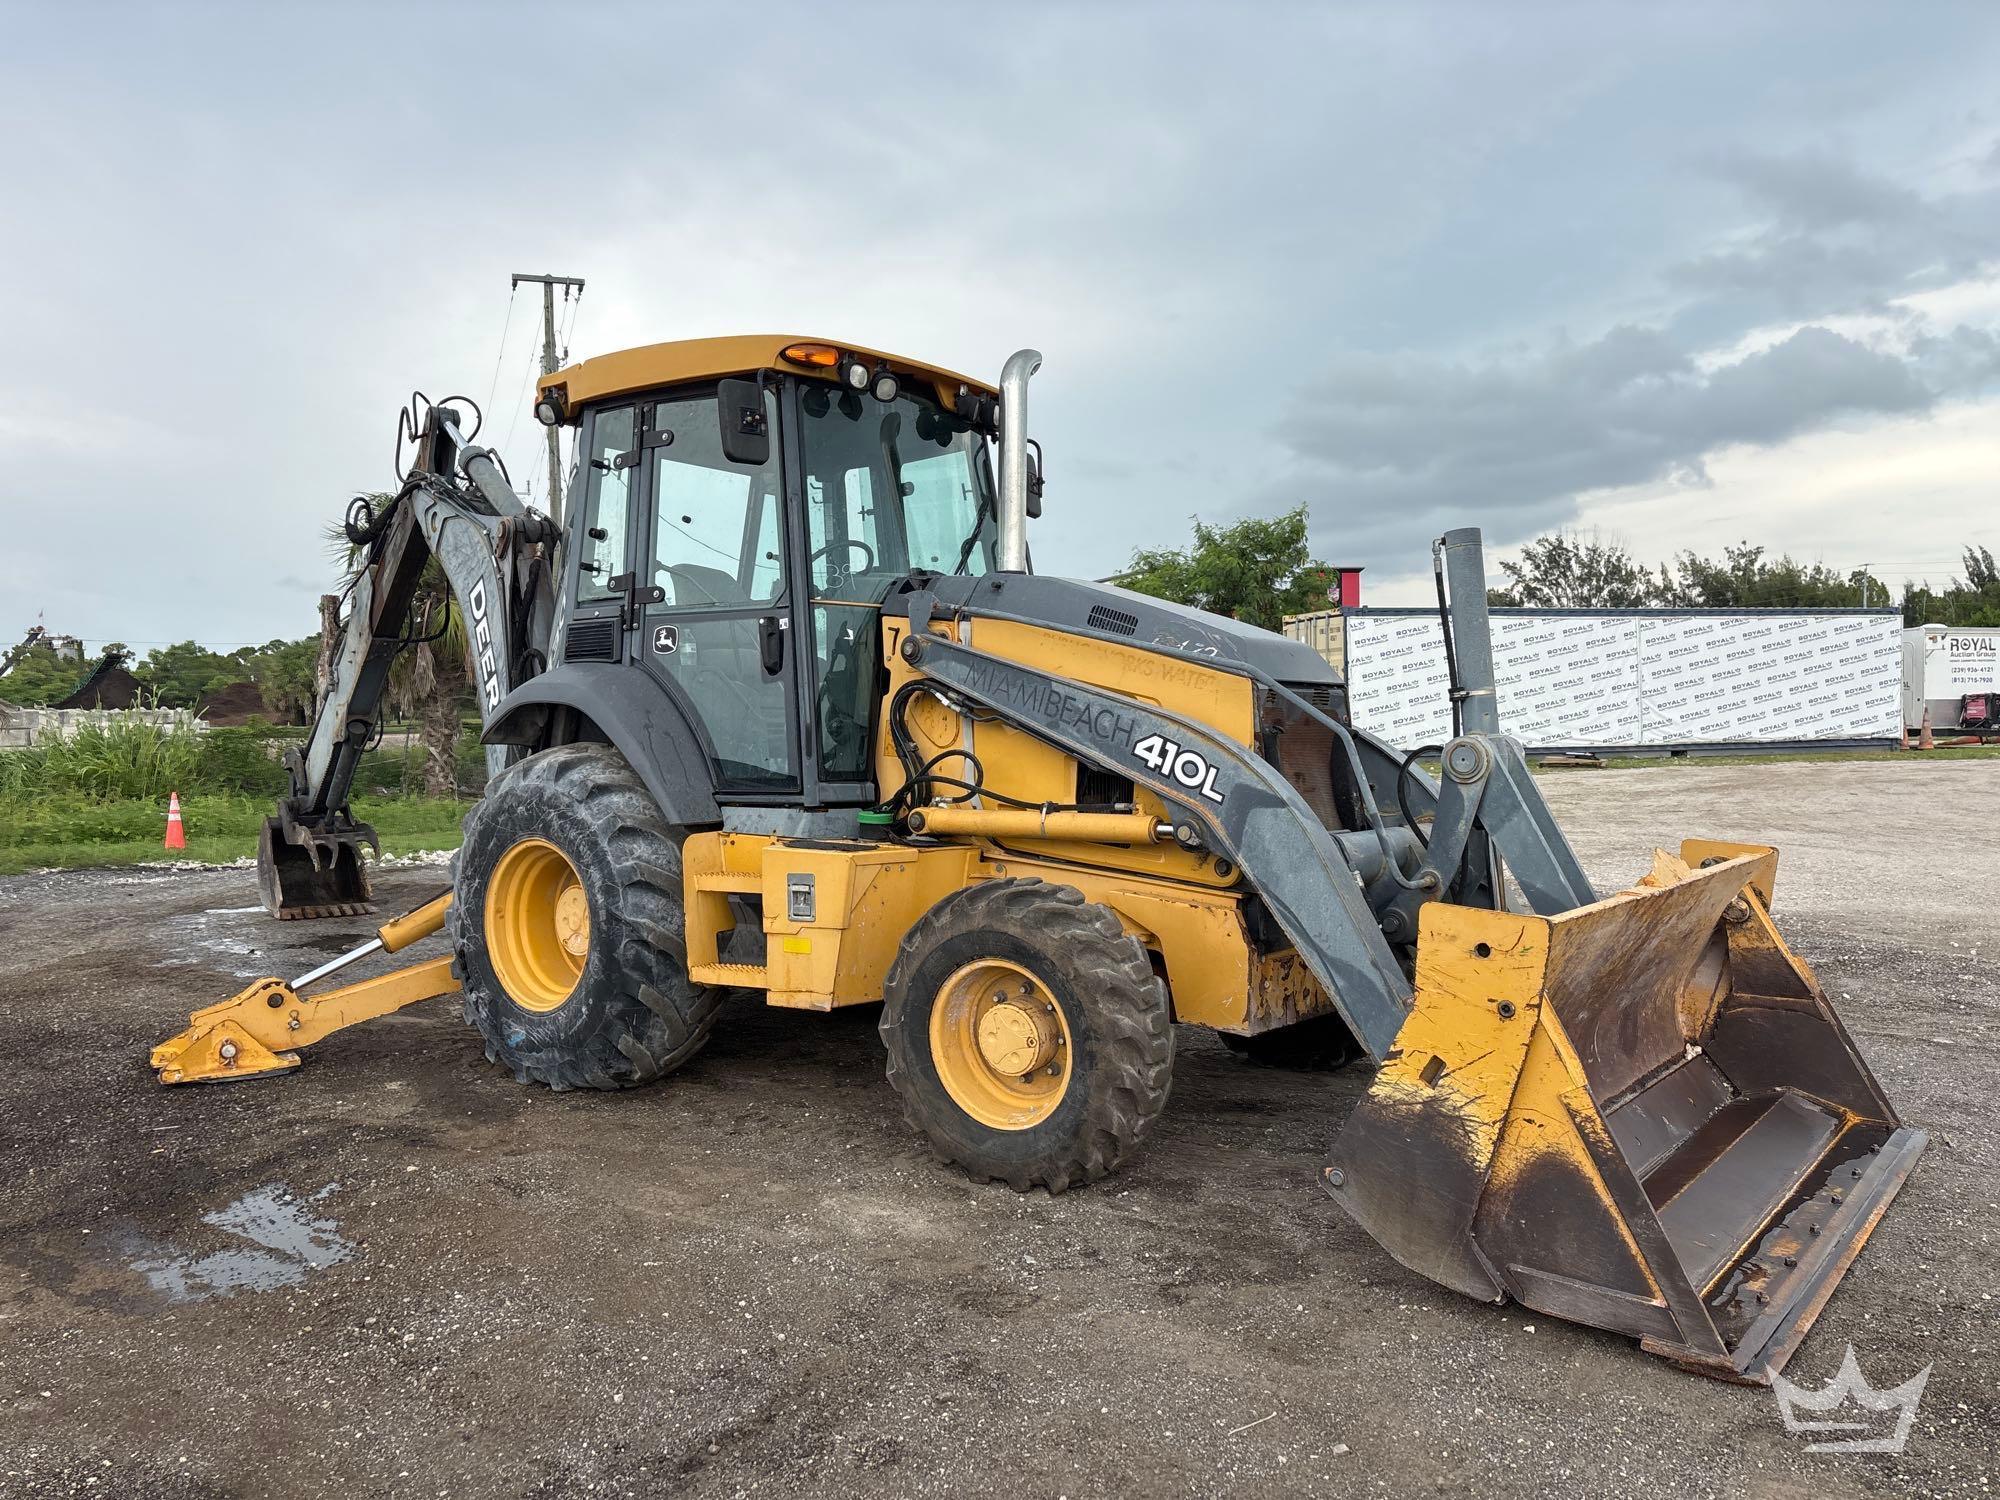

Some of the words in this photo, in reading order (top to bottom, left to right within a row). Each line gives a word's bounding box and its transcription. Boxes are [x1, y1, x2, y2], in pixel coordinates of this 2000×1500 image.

[1502, 621, 1527, 630] ROYAL
[1720, 618, 1743, 627] ROYAL
[1779, 620, 1801, 629] ROYAL
[1396, 627, 1421, 636] ROYAL
[1562, 624, 1587, 634] ROYAL
[1683, 626, 1706, 635] ROYAL
[1834, 624, 1856, 632] ROYAL
[1743, 629, 1765, 638] ROYAL
[1798, 632, 1820, 641] ROYAL
[1355, 636, 1380, 645] ROYAL
[1524, 634, 1548, 643] ROYAL
[1586, 637, 1610, 646] ROYAL
[1646, 635, 1669, 644] ROYAL
[1706, 638, 1729, 647] ROYAL
[1856, 634, 1877, 643] ROYAL
[469, 577, 500, 714] DEER
[1421, 640, 1445, 648] ROYA
[1491, 642, 1510, 650] OYAL
[1762, 641, 1784, 649] ROYAL
[1820, 643, 1842, 652] ROYAL
[1950, 638, 1996, 651] ROYAL
[1380, 648, 1405, 657] ROYAL
[1547, 646, 1572, 655] ROYAL
[1606, 649, 1630, 658] ROYAL
[1669, 647, 1692, 655] ROYAL
[1726, 650, 1749, 658] ROYAL
[1874, 646, 1895, 655] ROYAL
[1976, 651, 1996, 659] Group
[1351, 656, 1364, 664] YAL
[1508, 654, 1532, 663] ROYAL
[1784, 652, 1806, 660] ROYAL
[1840, 654, 1861, 663] ROYAL
[1402, 661, 1428, 670] ROYAL
[1568, 658, 1592, 667] ROYAL
[1689, 658, 1712, 667] ROYAL
[1748, 661, 1770, 670] ROYAL
[1529, 667, 1554, 676] ROYAL
[1652, 667, 1675, 676] ROYAL
[1803, 664, 1826, 672] ROYAL
[1860, 665, 1882, 674] ROYAL
[1362, 670, 1387, 679] ROYAL
[1427, 673, 1448, 682] ROYA
[1591, 669, 1615, 678] ROYAL
[1712, 670, 1735, 678] ROYAL
[1767, 672, 1790, 681] ROYAL
[1495, 675, 1514, 684] OYAL
[1674, 679, 1697, 687] ROYAL
[1825, 674, 1847, 683] ROYAL
[1386, 682, 1412, 691] ROYAL
[1553, 679, 1577, 688] ROYAL
[1612, 682, 1636, 691] ROYAL
[1732, 681, 1754, 690] ROYAL
[1789, 683, 1812, 692] ROYAL
[1353, 690, 1372, 699] OYAL
[1514, 688, 1538, 697] ROYAL
[1642, 687, 1660, 695] OYAL
[1695, 690, 1718, 699] ROYAL
[1845, 686, 1866, 694] ROYAL
[1408, 694, 1434, 704] ROYAL
[1574, 691, 1598, 700] ROYAL
[1753, 692, 1775, 701] ROYAL
[1809, 695, 1831, 703] ROYAL
[1535, 700, 1559, 709] ROYAL
[1657, 700, 1680, 708] ROYAL
[1866, 696, 1887, 705] ROYAL
[1368, 704, 1394, 713] ROYAL
[1596, 702, 1620, 711] ROYAL
[1718, 702, 1740, 710] ROYAL
[1773, 704, 1795, 712] ROYAL
[1831, 706, 1852, 714] ROYAL
[1433, 707, 1452, 715] ROYA
[1558, 711, 1582, 720] ROYAL
[1680, 711, 1702, 719] ROYAL
[1392, 716, 1418, 725] ROYAL
[1618, 715, 1638, 723] ROYA
[1737, 713, 1759, 722] ROYAL
[1795, 715, 1817, 723] ROYAL
[1850, 716, 1871, 725] ROYAL
[1519, 721, 1544, 730] ROYAL
[1579, 723, 1603, 732] ROYAL
[1642, 720, 1665, 728] ROYAL
[1701, 722, 1723, 731] ROYAL
[1759, 724, 1781, 732] ROYAL
[1415, 728, 1440, 737] ROYAL
[1815, 726, 1837, 734] ROYAL
[1386, 736, 1397, 744] YAL
[1541, 733, 1565, 742] ROYAL
[1663, 731, 1686, 740] ROYAL
[1132, 733, 1225, 805] 410L
